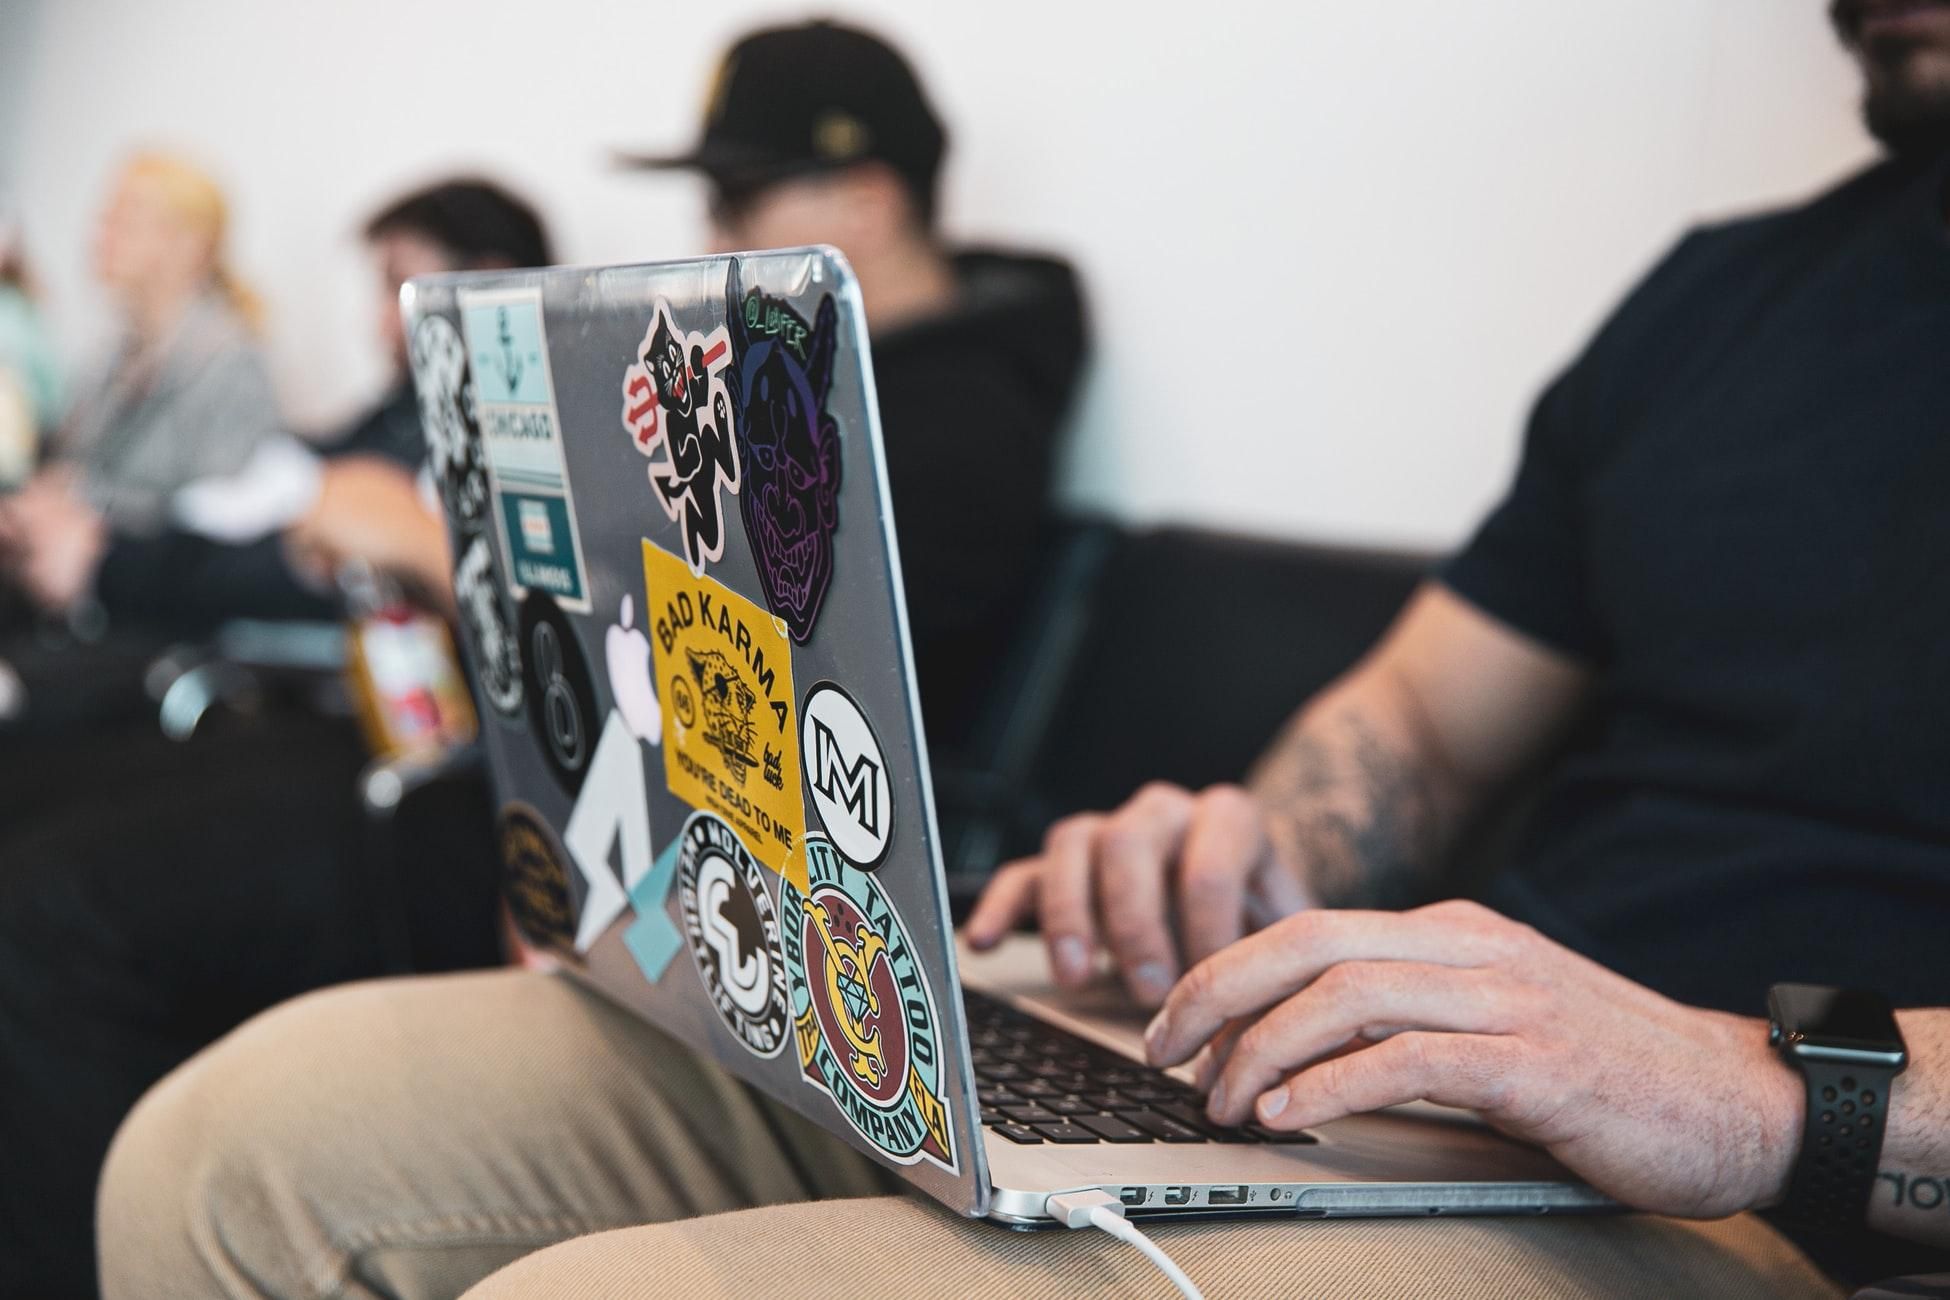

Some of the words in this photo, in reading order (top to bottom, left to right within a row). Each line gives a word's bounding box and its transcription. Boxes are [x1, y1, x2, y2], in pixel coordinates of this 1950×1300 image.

[657, 591, 694, 655] BAD
[698, 590, 788, 734] KARMA
[719, 780, 751, 817] DEAD
[753, 805, 771, 832] TO
[773, 820, 794, 850] ME
[784, 881, 805, 992] YBOR
[865, 880, 934, 1066] TATTOO
[819, 1050, 922, 1150] COMPANY
